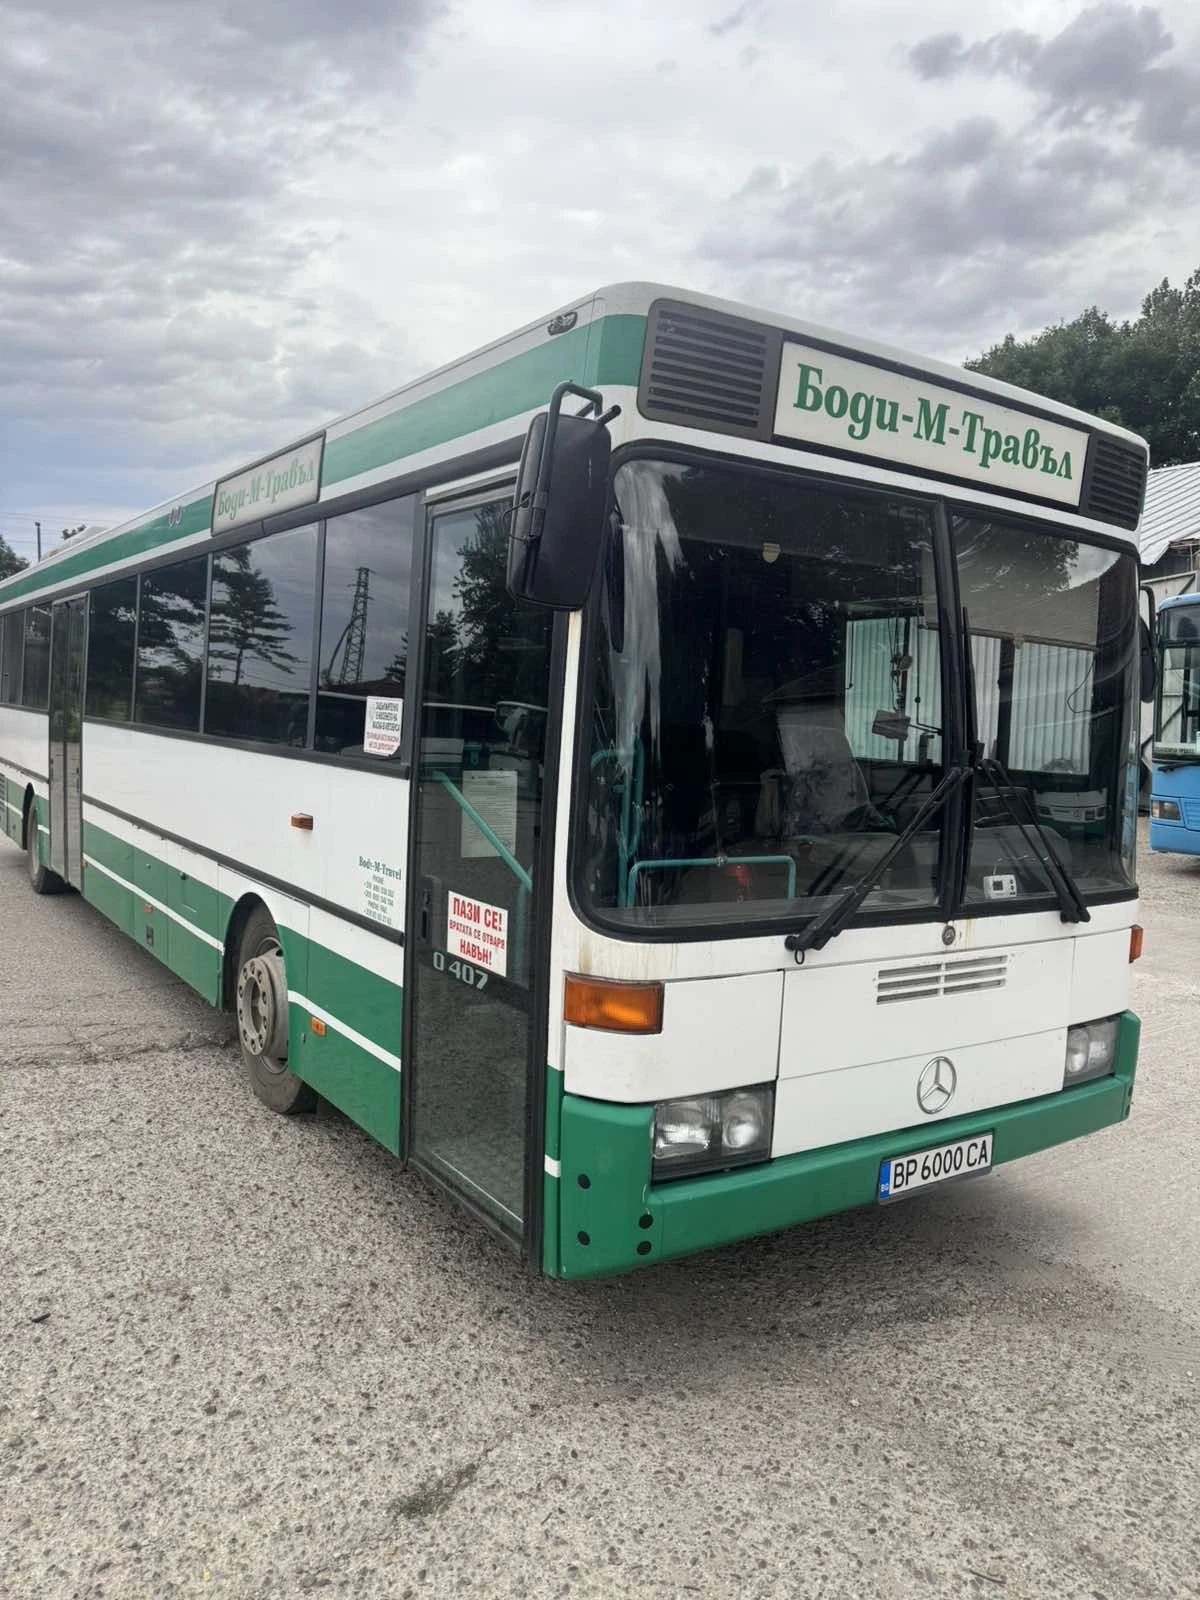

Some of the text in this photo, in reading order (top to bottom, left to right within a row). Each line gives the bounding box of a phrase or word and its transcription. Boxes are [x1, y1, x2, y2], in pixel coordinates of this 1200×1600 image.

[453, 897, 502, 932] ПАЗИ СЕ!
[474, 929, 481, 940] СЕ
[460, 938, 492, 966] НАВЪН!
[448, 961, 489, 990] 407
[921, 1146, 964, 1181] 6000
